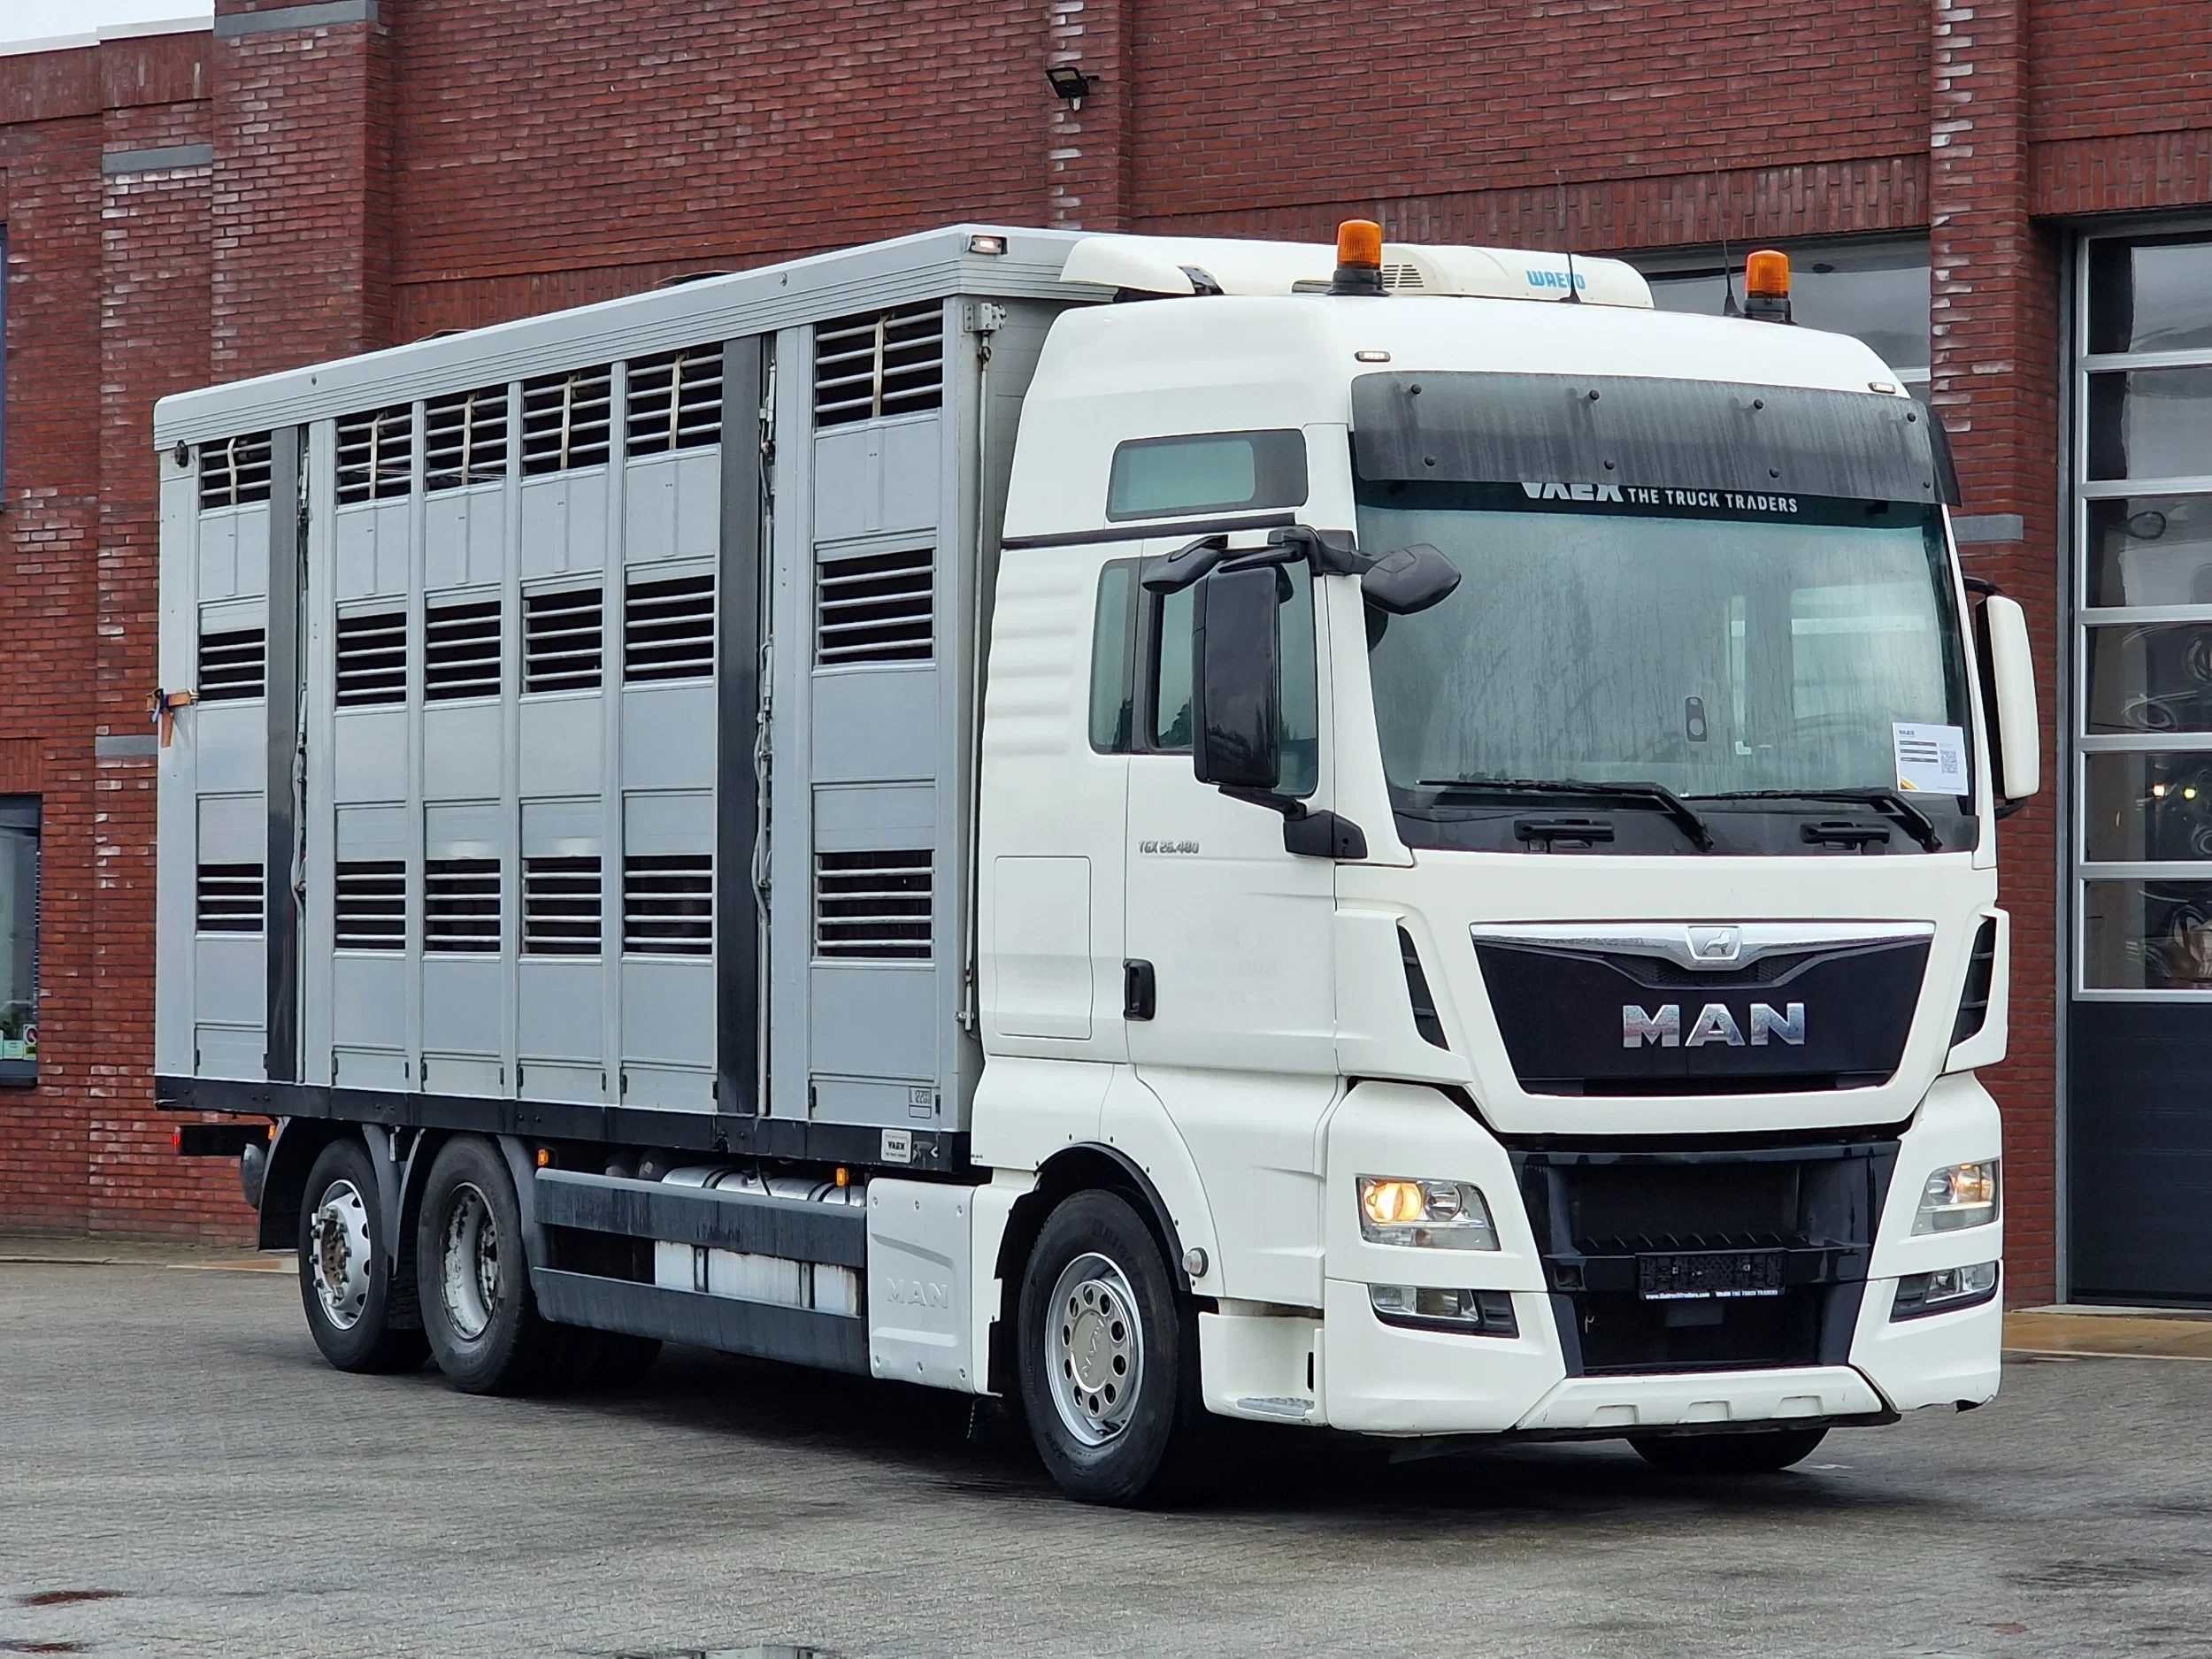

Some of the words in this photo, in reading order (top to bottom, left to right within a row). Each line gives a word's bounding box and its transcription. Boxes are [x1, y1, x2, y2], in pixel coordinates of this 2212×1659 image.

[1521, 482, 1624, 502] VAEX
[1627, 488, 1660, 504] THE
[1664, 489, 1720, 508] TRUCK
[1724, 493, 1798, 513] TRADERS
[1138, 841, 1158, 854] TGX
[1623, 1002, 1806, 1048] MAN
[887, 1141, 905, 1150] VAEX
[887, 1277, 948, 1309] MAN
